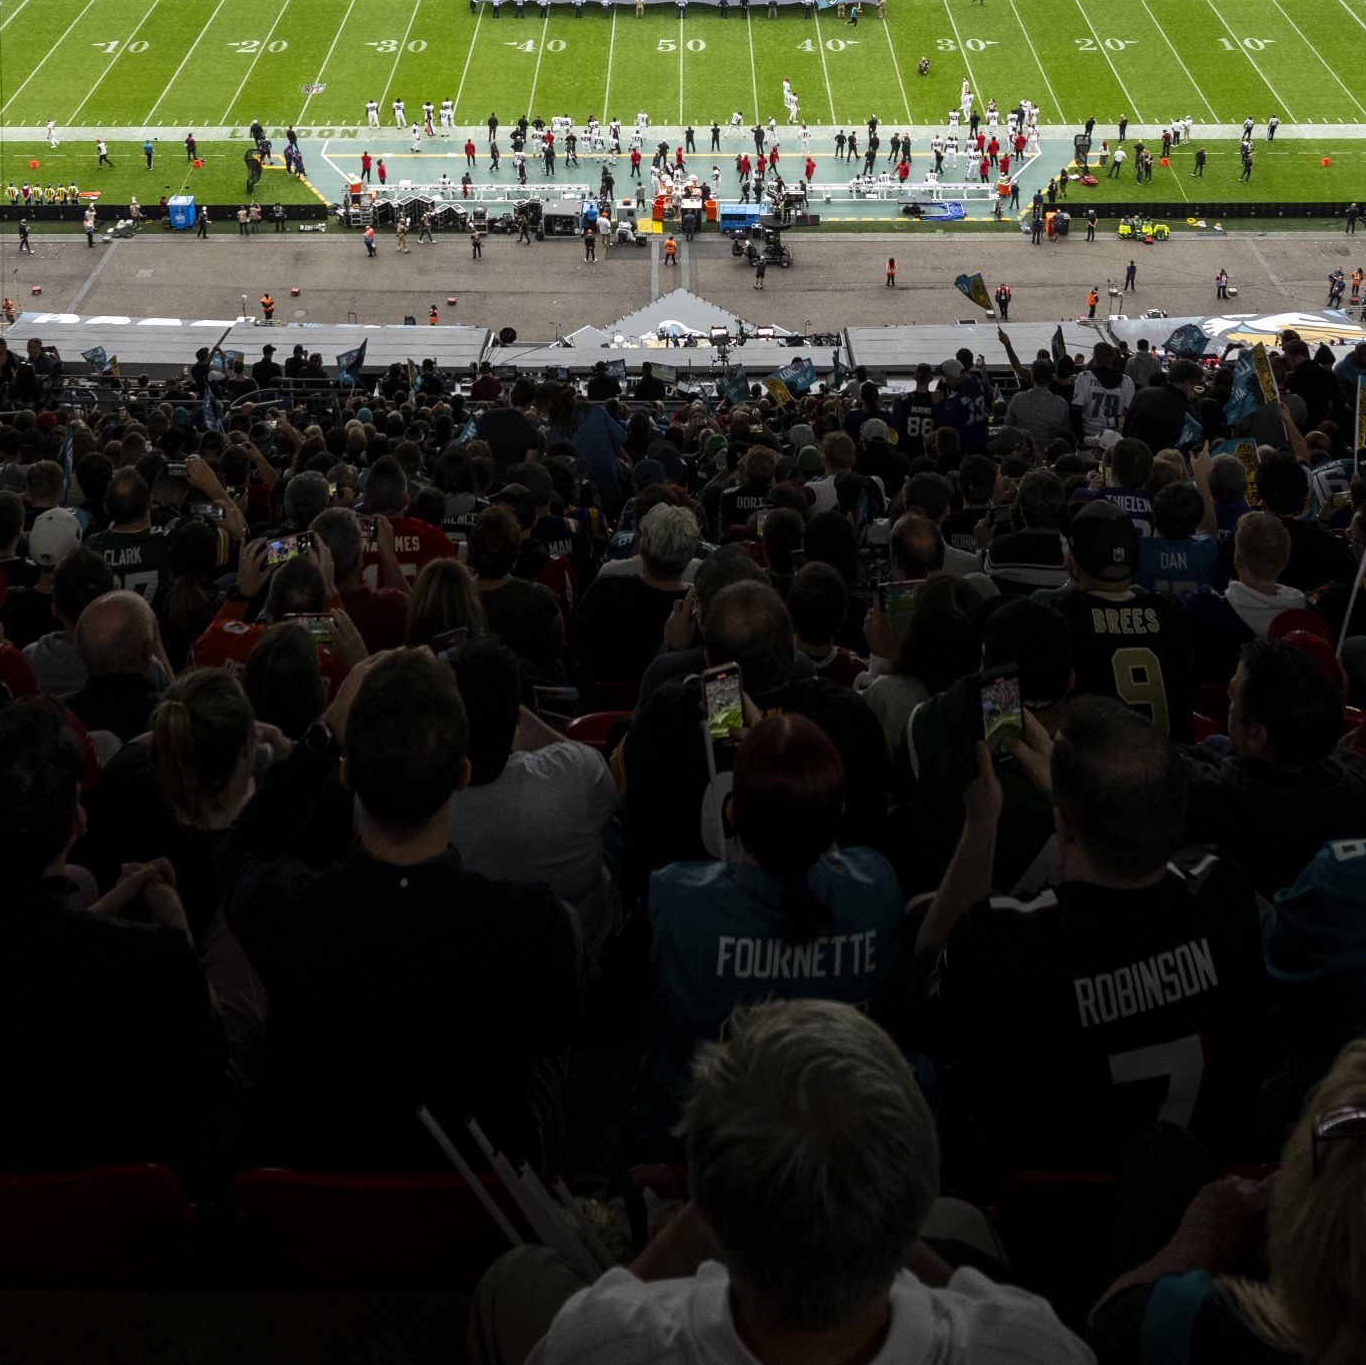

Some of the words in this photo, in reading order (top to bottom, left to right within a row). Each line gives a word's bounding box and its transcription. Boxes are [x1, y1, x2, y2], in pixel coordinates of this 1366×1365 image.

[101, 40, 149, 53] 10
[235, 40, 288, 53] 20
[376, 40, 428, 53] 30
[516, 40, 567, 53] 40
[656, 39, 706, 52] 50
[797, 39, 846, 52] 40
[936, 38, 986, 52] 30
[1074, 38, 1125, 51] 20
[1217, 38, 1265, 51] 10
[229, 128, 359, 139] LNDON
[905, 416, 934, 437] 88
[359, 534, 419, 552] MAMES
[103, 546, 141, 567] CLARK
[1160, 554, 1186, 570] DAN
[1092, 607, 1161, 635] BREES
[1111, 646, 1171, 736] 9
[716, 929, 878, 980] FOURNETTE
[1074, 937, 1219, 1028] ROBINSON
[1108, 1034, 1212, 1130] 7
